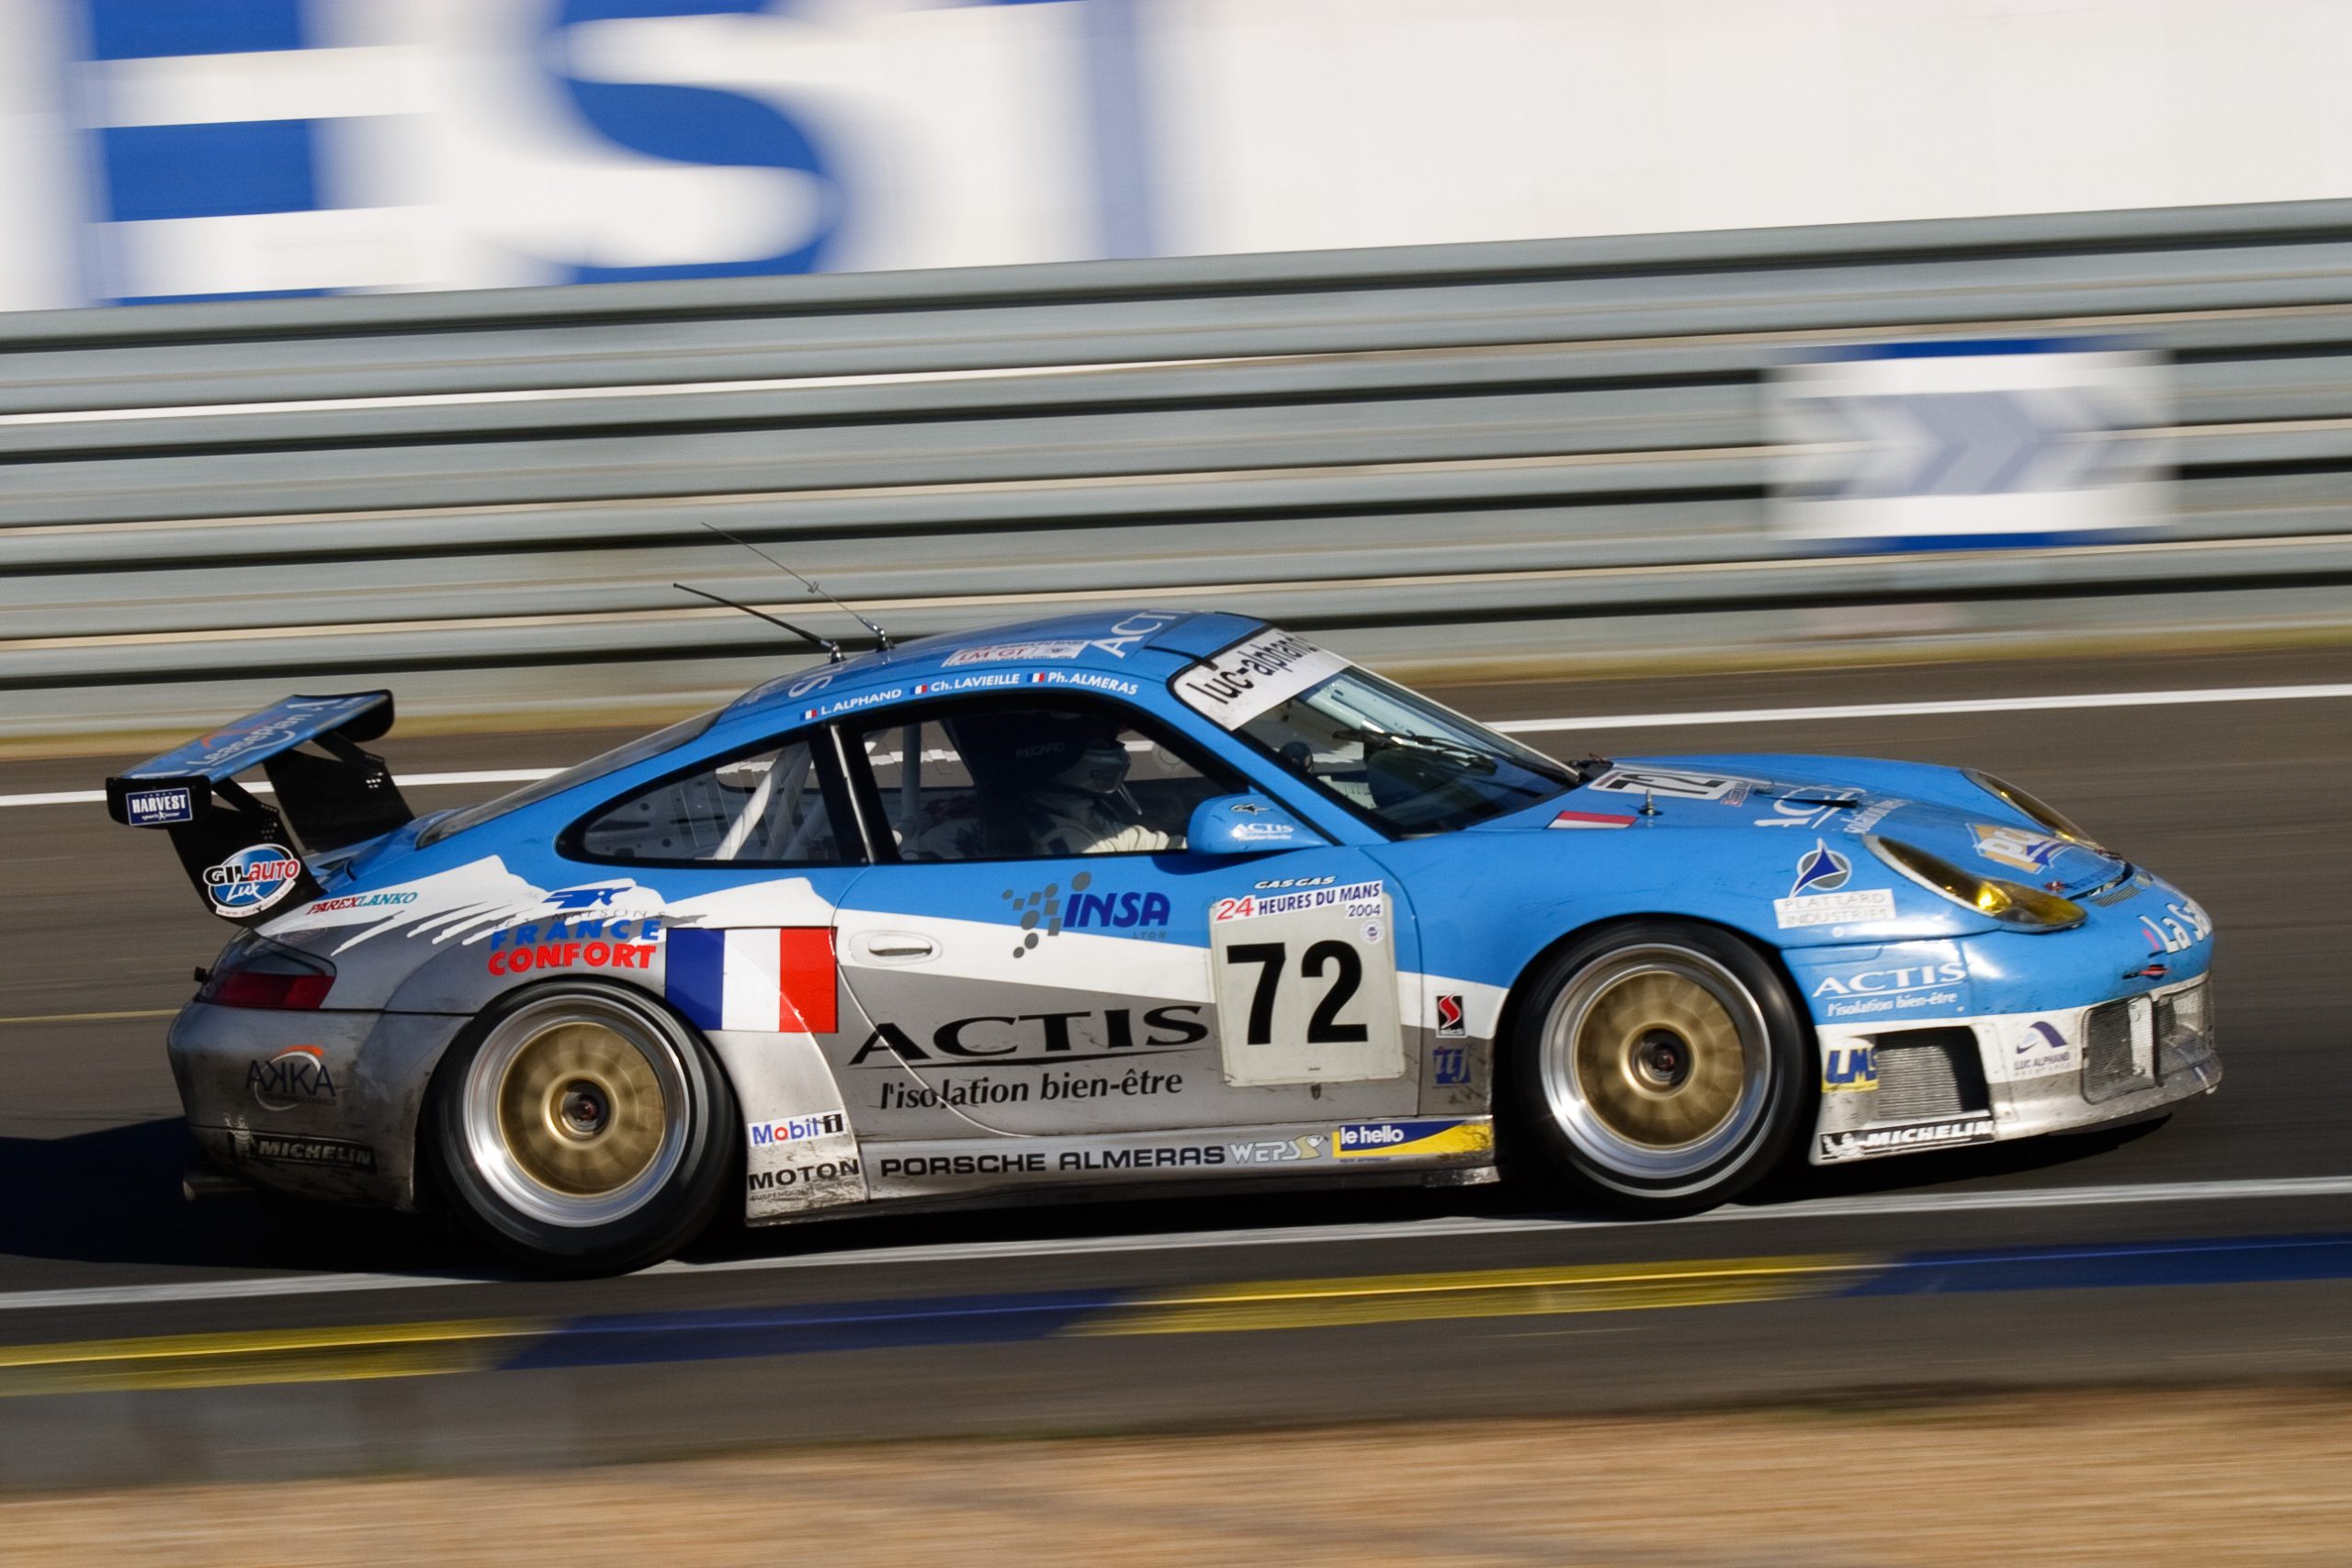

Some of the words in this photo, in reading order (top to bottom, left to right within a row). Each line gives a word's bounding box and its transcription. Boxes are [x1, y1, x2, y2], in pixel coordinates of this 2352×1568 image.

[131, 795, 187, 814] HARVEST
[1217, 898, 1254, 920] 24
[1259, 894, 1312, 916] HEURES
[1316, 890, 1335, 906] DU
[1340, 884, 1380, 901] MANS
[1348, 904, 1381, 918] 2004
[491, 919, 662, 952] FRANCE
[488, 942, 657, 976] CONFORT
[1227, 940, 1368, 1045] 72
[1812, 962, 1968, 998] ACTIS
[849, 1005, 1209, 1065] ACTIS
[245, 1059, 336, 1097] AKKA
[880, 1077, 1029, 1110] l'isolation
[1040, 1067, 1183, 1100] bien-être
[752, 1117, 820, 1145] Mobil
[1340, 1127, 1358, 1145] le
[1360, 1125, 1405, 1144] hello
[1865, 1120, 1995, 1147] MICHELIN
[258, 1141, 371, 1165] MICHELIN
[881, 1154, 1046, 1177] PORSCHE
[1059, 1146, 1225, 1171] ALMERAS
[748, 1159, 860, 1190] MOTON
